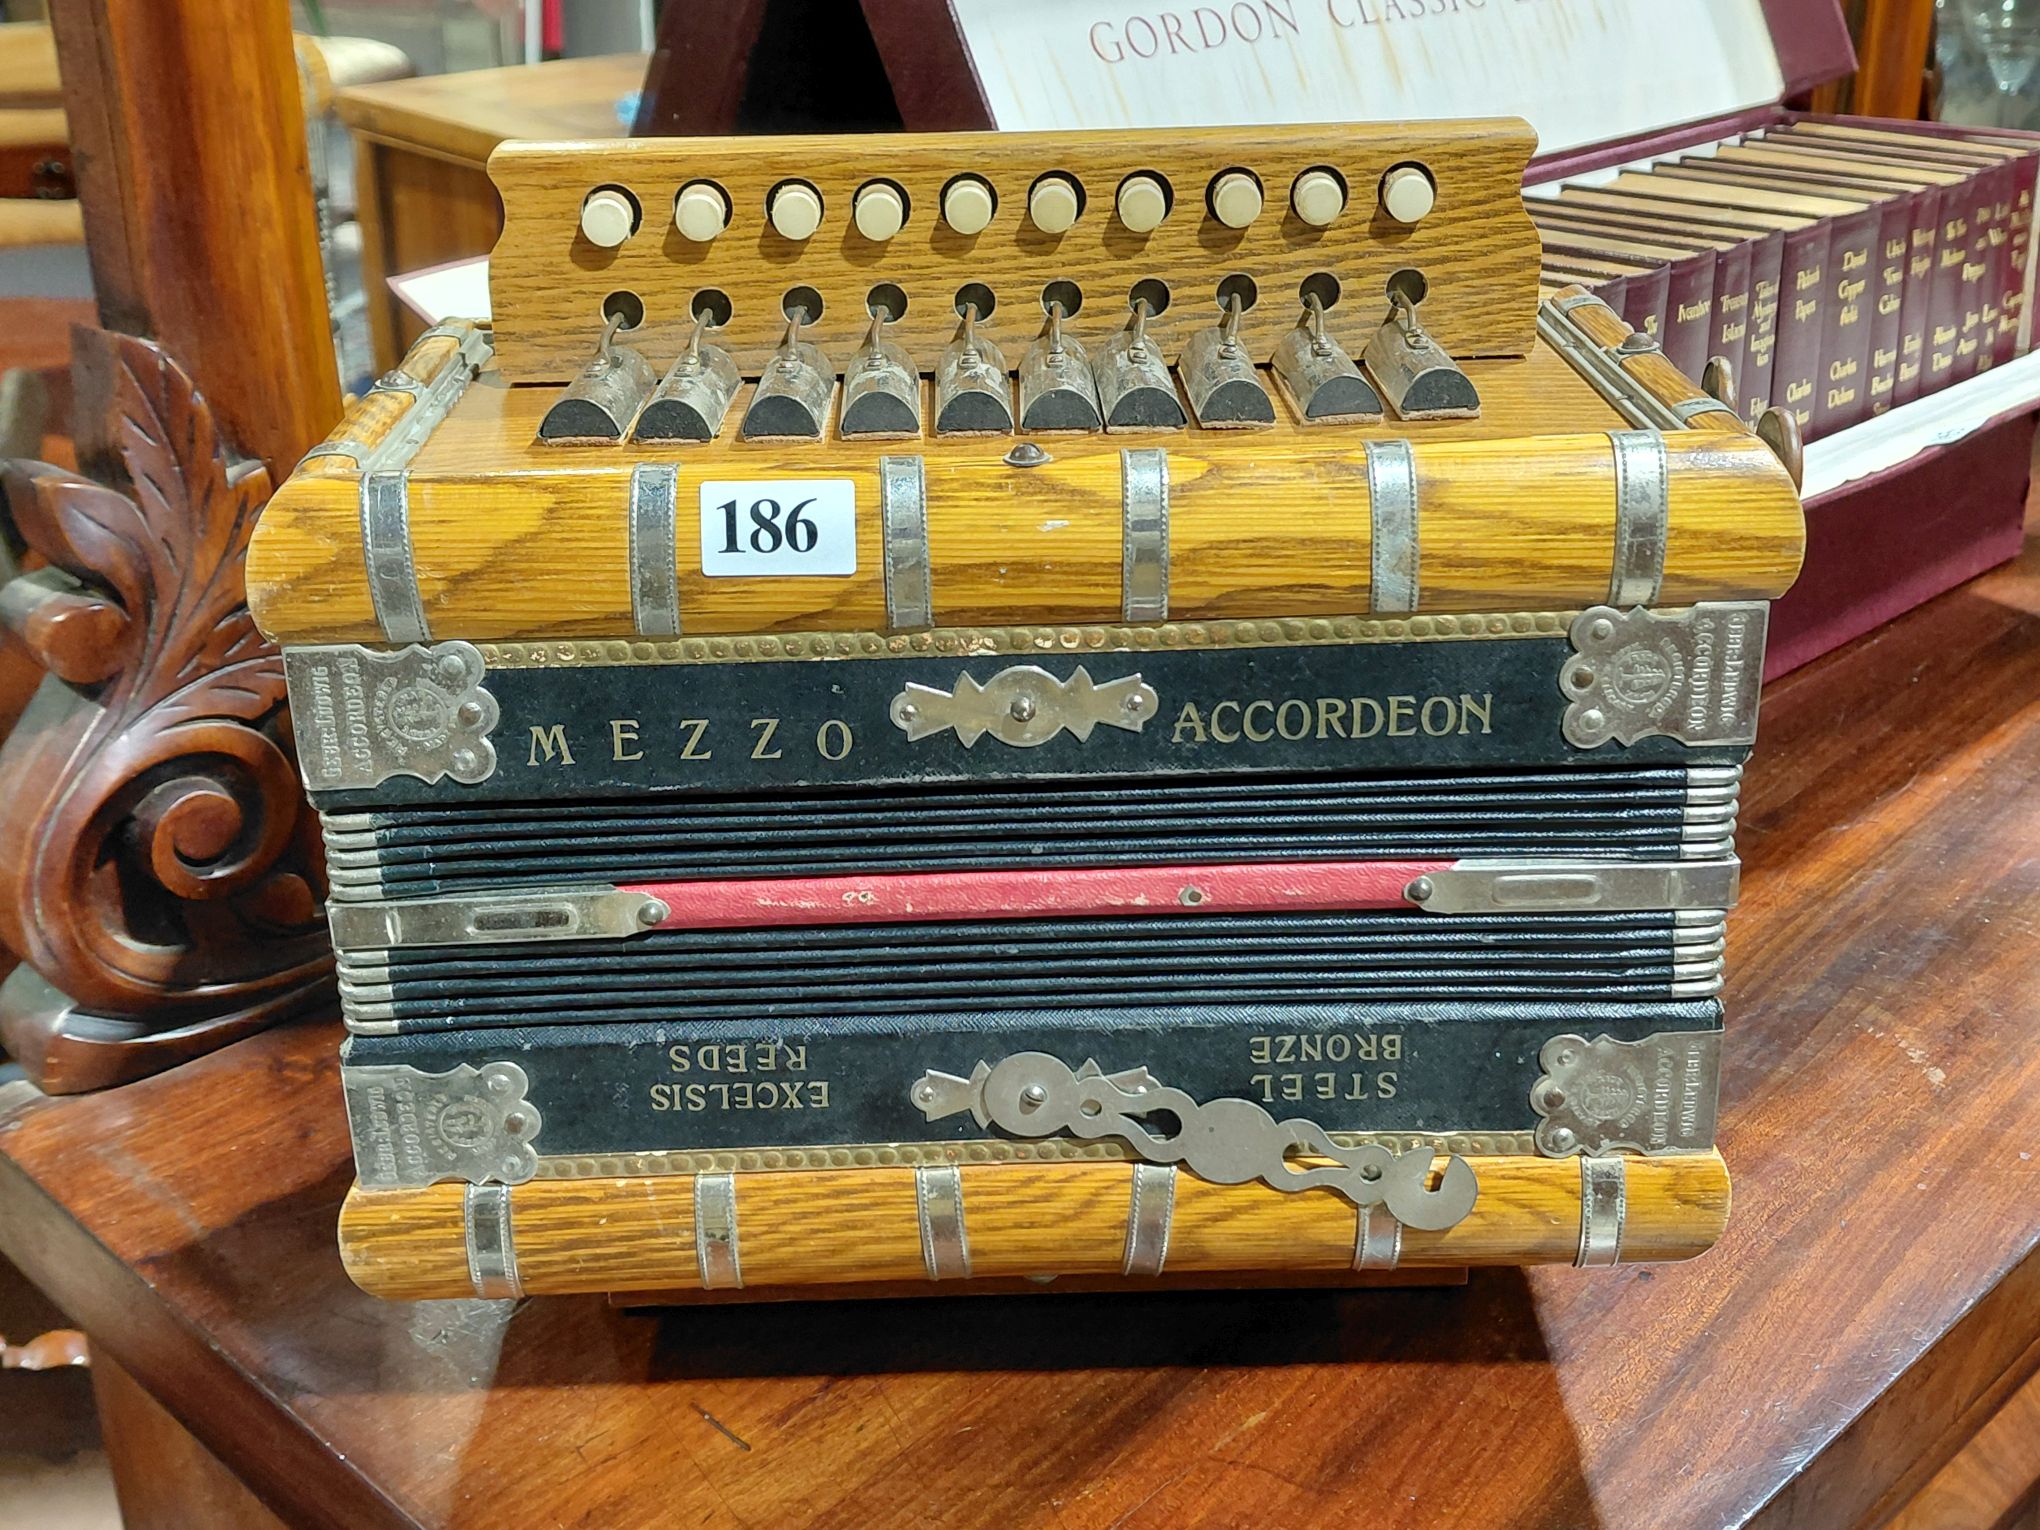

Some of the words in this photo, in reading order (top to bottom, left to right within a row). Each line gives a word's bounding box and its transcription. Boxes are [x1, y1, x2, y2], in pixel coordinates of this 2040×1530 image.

[1089, 0, 1301, 64] GORDON
[716, 497, 818, 554] 186
[526, 718, 853, 767] MEZZO
[1171, 693, 1493, 743] ACCORDEON
[669, 1043, 807, 1073] REEDS
[1250, 1033, 1402, 1064] BRONZE
[650, 1081, 830, 1112] EXCELSIS
[1250, 1071, 1399, 1102] STEEL
